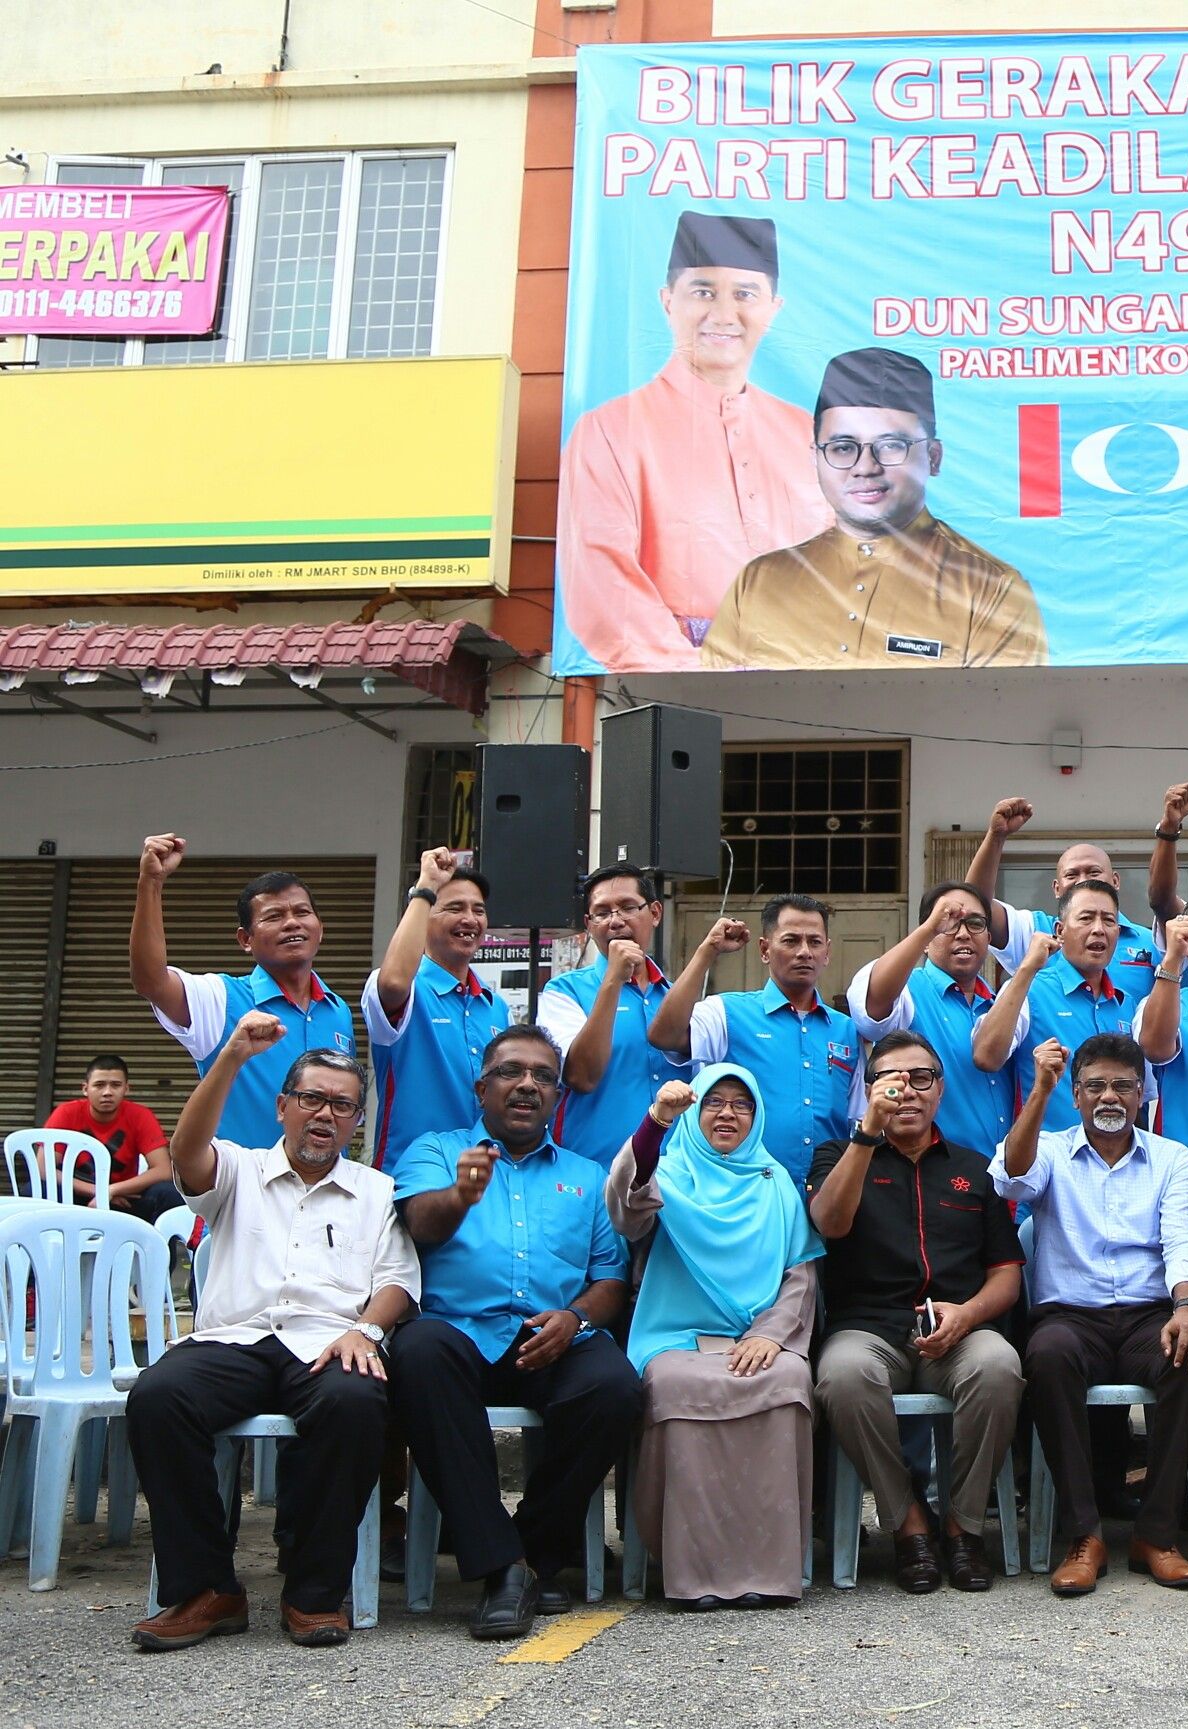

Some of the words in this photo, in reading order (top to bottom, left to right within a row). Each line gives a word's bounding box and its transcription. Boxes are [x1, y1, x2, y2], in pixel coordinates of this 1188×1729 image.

[638, 61, 856, 126] BILIK
[603, 133, 848, 201] PARTI
[873, 297, 989, 337] DUN
[939, 346, 1128, 378] PARLIMEN
[202, 569, 245, 579] Dimiliki
[248, 569, 273, 578] oleh
[284, 568, 303, 577] RM
[306, 567, 347, 577] JMART
[352, 566, 377, 576] SDN
[381, 565, 406, 575] BHD
[409, 564, 470, 576] (884898-K)
[484, 948, 501, 959] 5143
